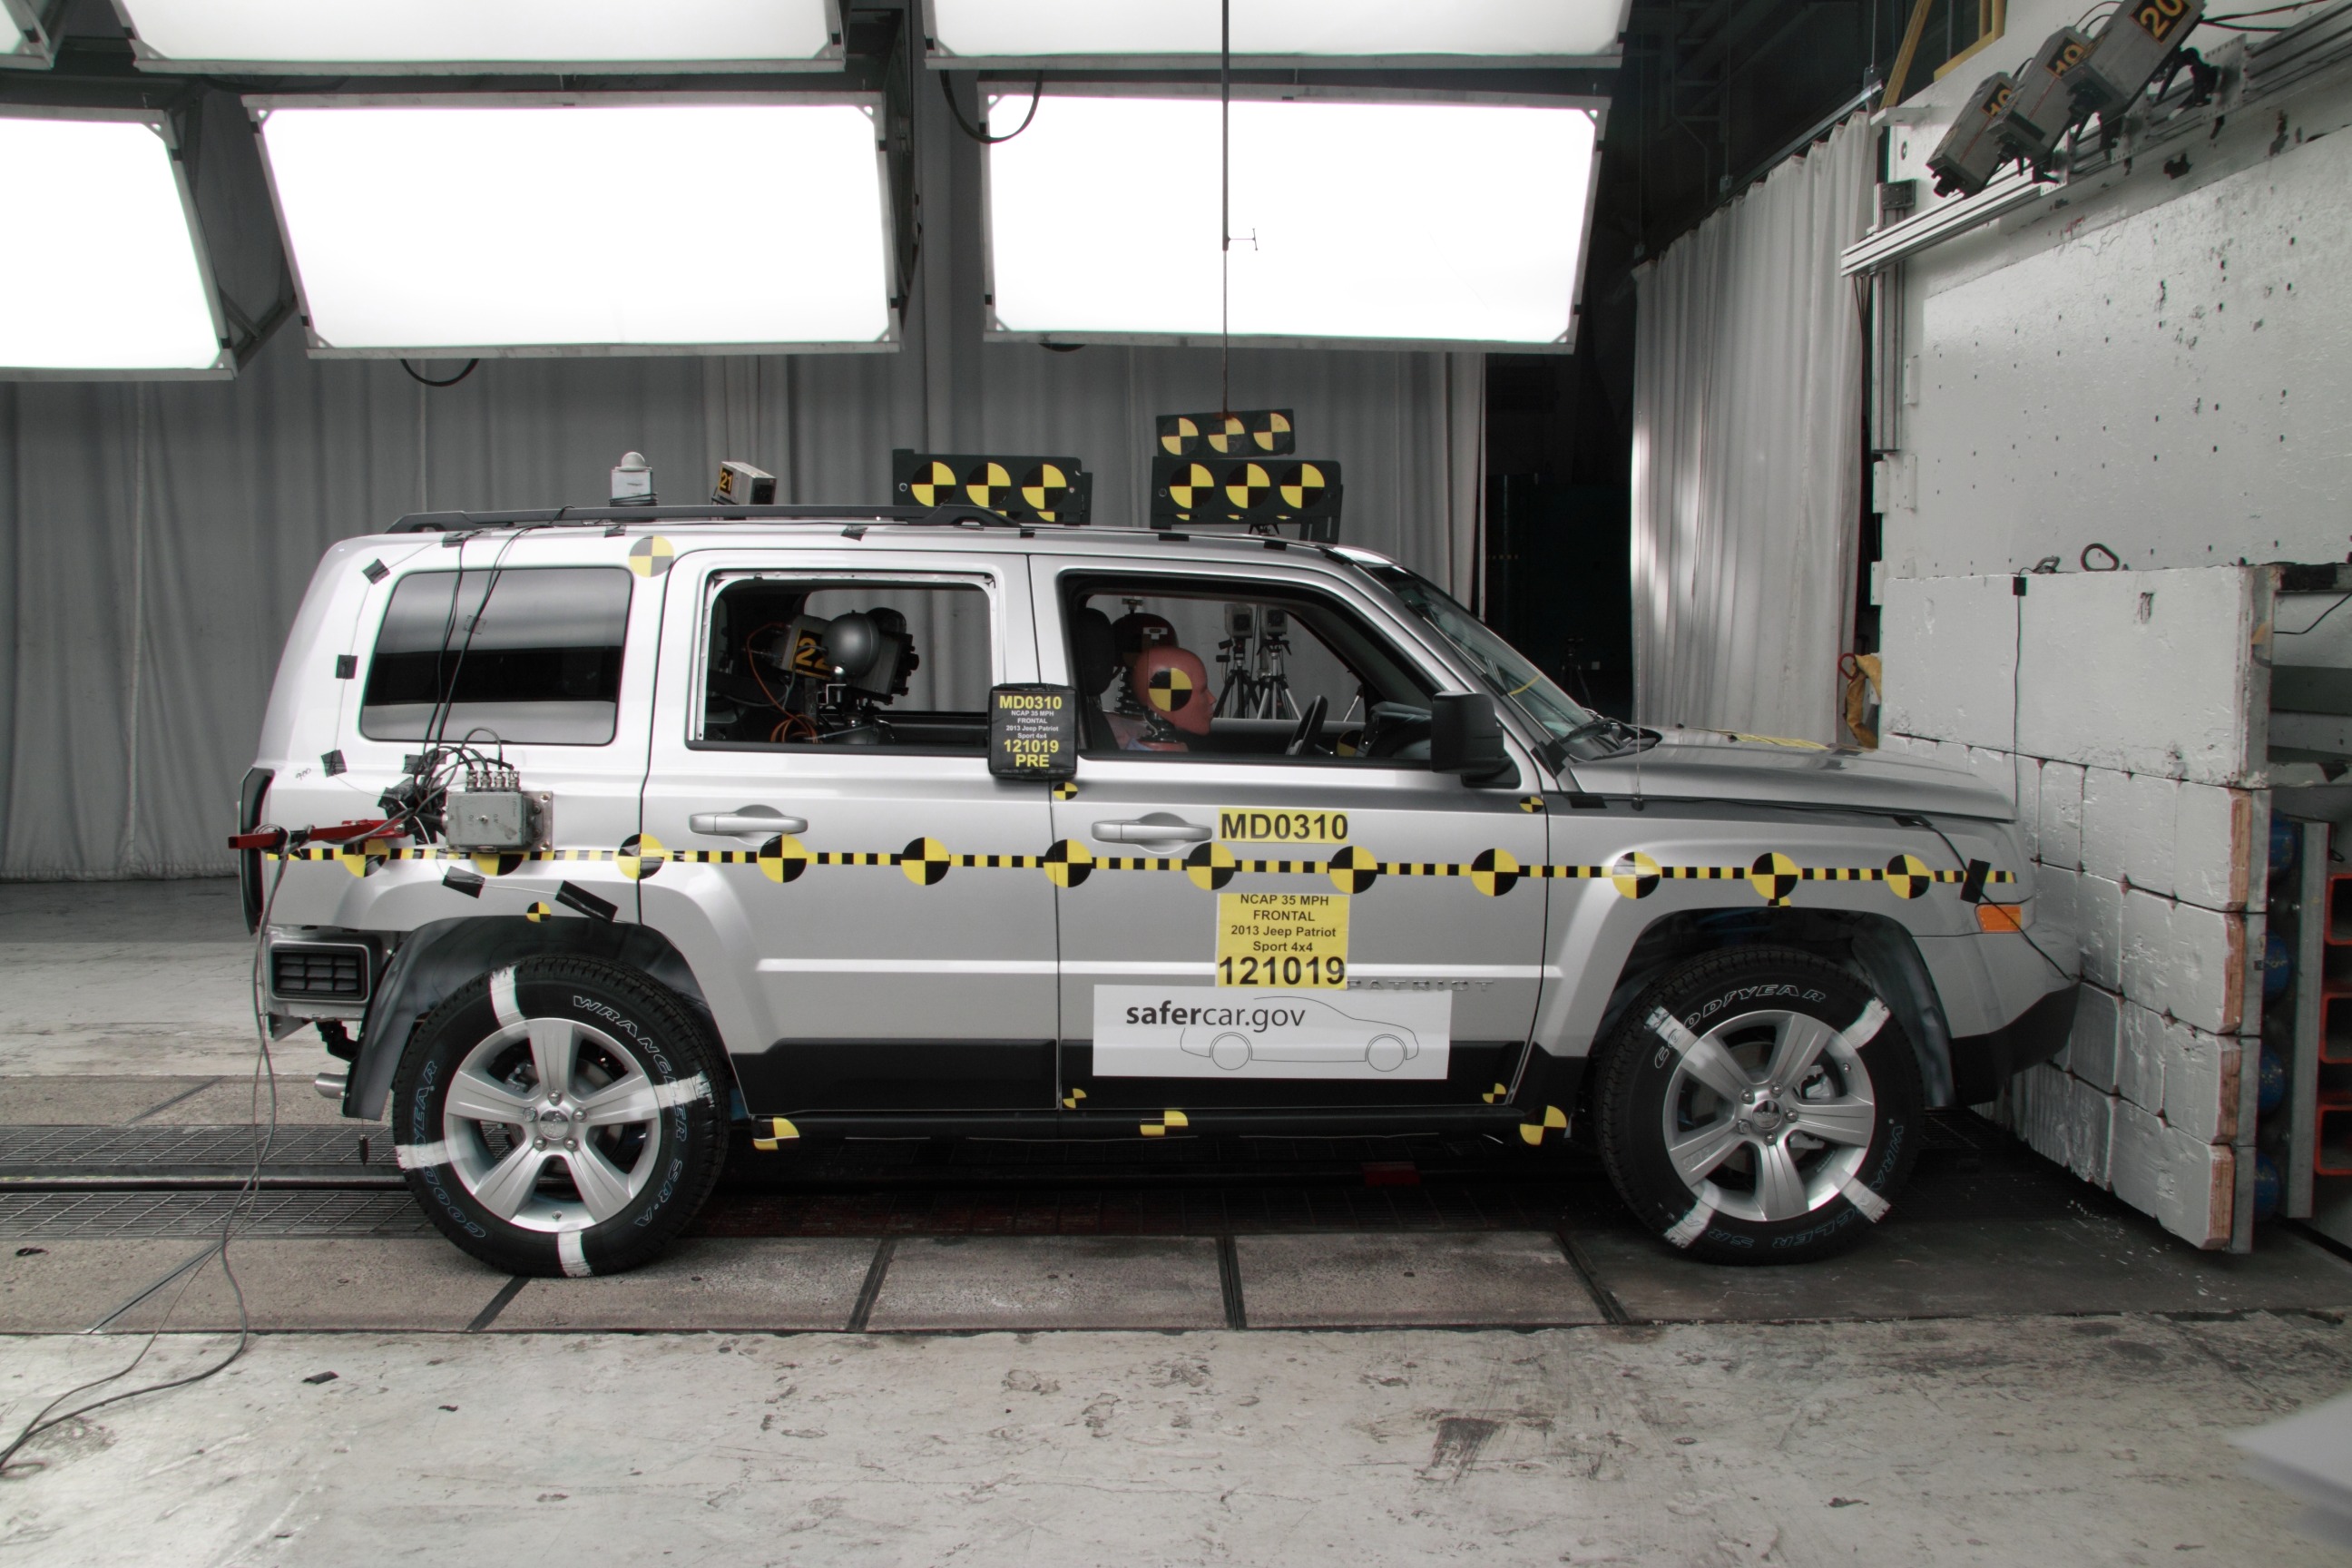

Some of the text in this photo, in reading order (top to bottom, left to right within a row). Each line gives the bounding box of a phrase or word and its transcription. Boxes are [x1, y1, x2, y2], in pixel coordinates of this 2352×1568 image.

[720, 472, 733, 492] 21
[999, 695, 1062, 710] MD0310
[1004, 740, 1059, 753] 121019
[1015, 754, 1050, 768] PRE
[1221, 813, 1348, 840] MD0310
[1240, 894, 1329, 906] NCAP 35 MPH
[1253, 910, 1315, 922] FRONTAL
[1230, 925, 1337, 938] 2013 Jeep Patriot
[1253, 941, 1313, 953] Sport 4x4
[1219, 956, 1346, 985] 121019
[1126, 1000, 1306, 1034] safercar.gov
[1654, 985, 1827, 1069] GOODYEAR
[572, 995, 688, 1142] WRANGLER
